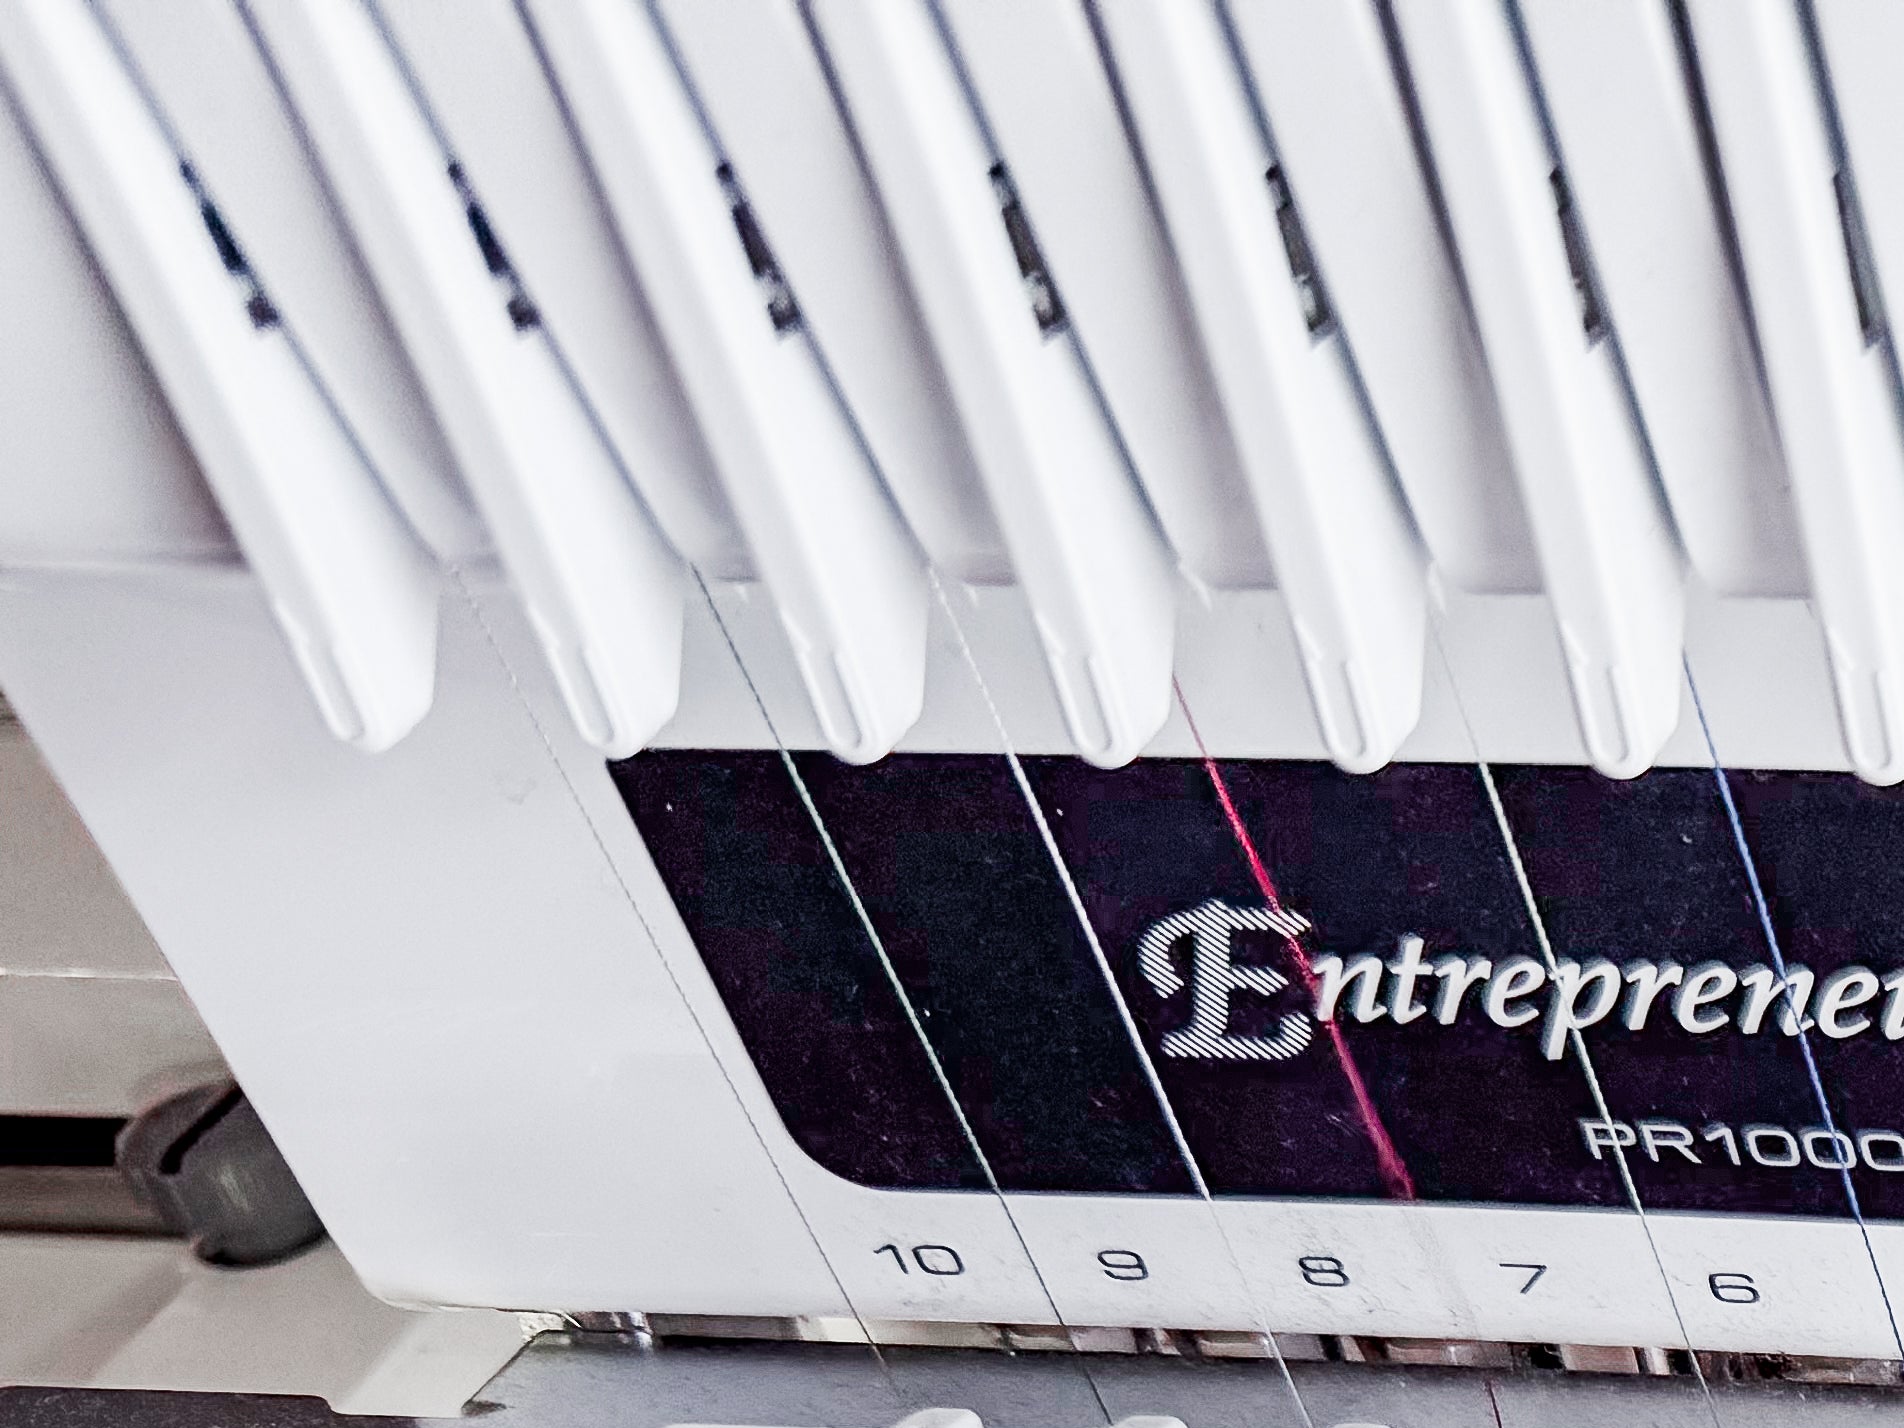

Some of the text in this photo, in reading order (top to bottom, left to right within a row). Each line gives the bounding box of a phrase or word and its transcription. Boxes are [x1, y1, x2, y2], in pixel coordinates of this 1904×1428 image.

[873, 1243, 964, 1277] 10
[1096, 1249, 1149, 1282] 9
[1298, 1255, 1350, 1289] 8
[1497, 1261, 1547, 1296] 7
[1708, 1271, 1760, 1305] 6
